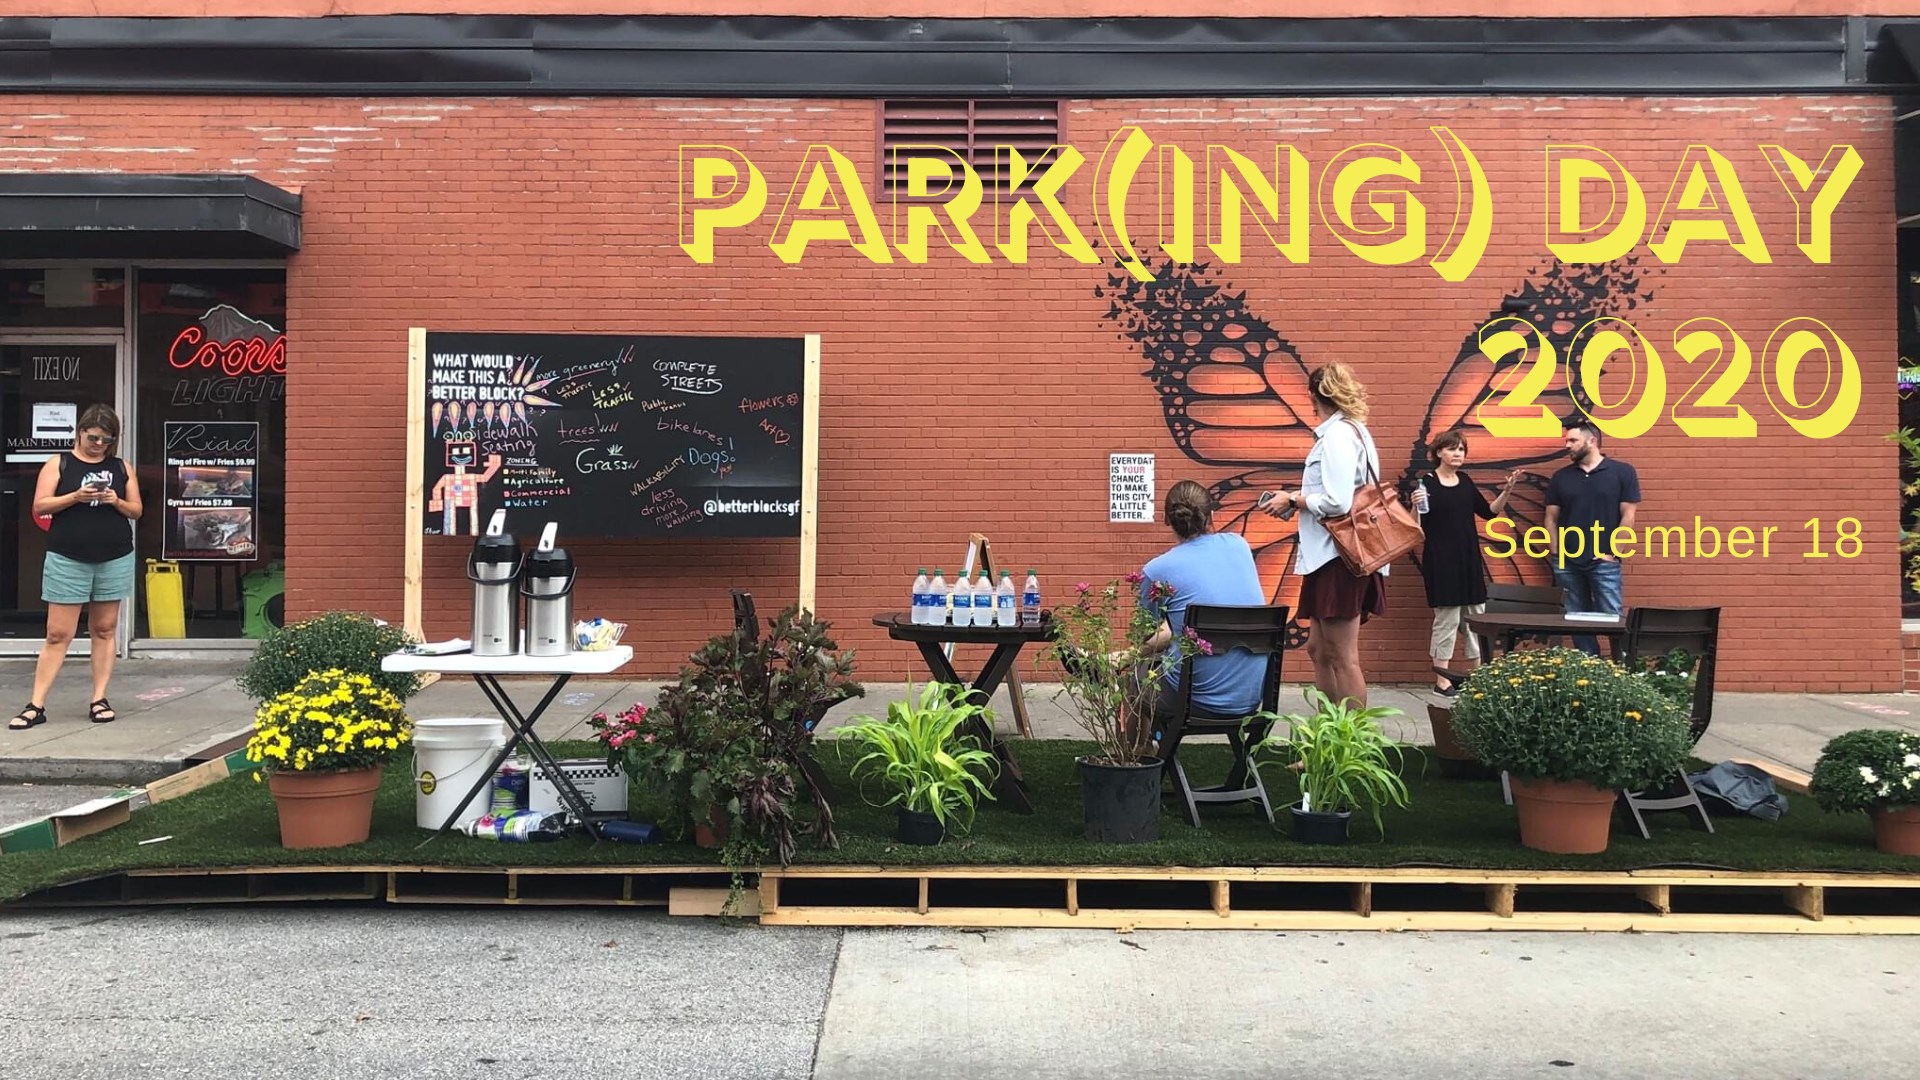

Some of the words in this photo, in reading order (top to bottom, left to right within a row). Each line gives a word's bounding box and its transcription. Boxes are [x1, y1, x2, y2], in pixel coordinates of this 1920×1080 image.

[168, 326, 287, 376] Coors
[432, 353, 468, 368] WHAT
[471, 354, 514, 369] WOULD
[563, 359, 618, 377] greenery
[652, 359, 718, 375] COMPLETE
[432, 369, 466, 385] MAKE
[468, 370, 495, 385] THIS
[497, 370, 506, 385] A
[660, 373, 724, 391] STREETS
[171, 374, 287, 406] LIGHT
[432, 385, 477, 400] BETTER
[479, 385, 525, 401] BLOCK?
[592, 390, 635, 409] TRAFFIC
[738, 396, 785, 414] flowers
[166, 423, 256, 452] Riad
[657, 416, 690, 433] bike
[693, 421, 725, 446] lanes
[7, 437, 38, 447] MAIN
[168, 458, 184, 467] Ring
[185, 458, 192, 466] of
[193, 458, 206, 466] Fire
[217, 458, 234, 466] Fries
[505, 457, 538, 465] ZONING
[575, 447, 628, 474] Grass
[688, 436, 737, 474] Dogs!
[1111, 456, 1153, 466] EVERYDAY
[629, 454, 686, 497] WALKABILITY
[1111, 465, 1120, 474] IS
[1122, 465, 1146, 474] YOUR
[511, 477, 565, 489] Agriculture
[1111, 474, 1145, 483] CHANCE
[511, 487, 571, 498] Commercial
[650, 488, 676, 504] less
[1111, 484, 1122, 492] TO
[1124, 484, 1148, 492] MAKE
[167, 498, 184, 507] Gyro
[512, 499, 548, 507] Water
[1111, 493, 1130, 501] THIS
[1132, 493, 1151, 501] CITY
[641, 497, 689, 516] driving
[703, 499, 801, 517] @betterblocksgf
[1111, 502, 1117, 510] A
[1119, 502, 1147, 510] LITTLE
